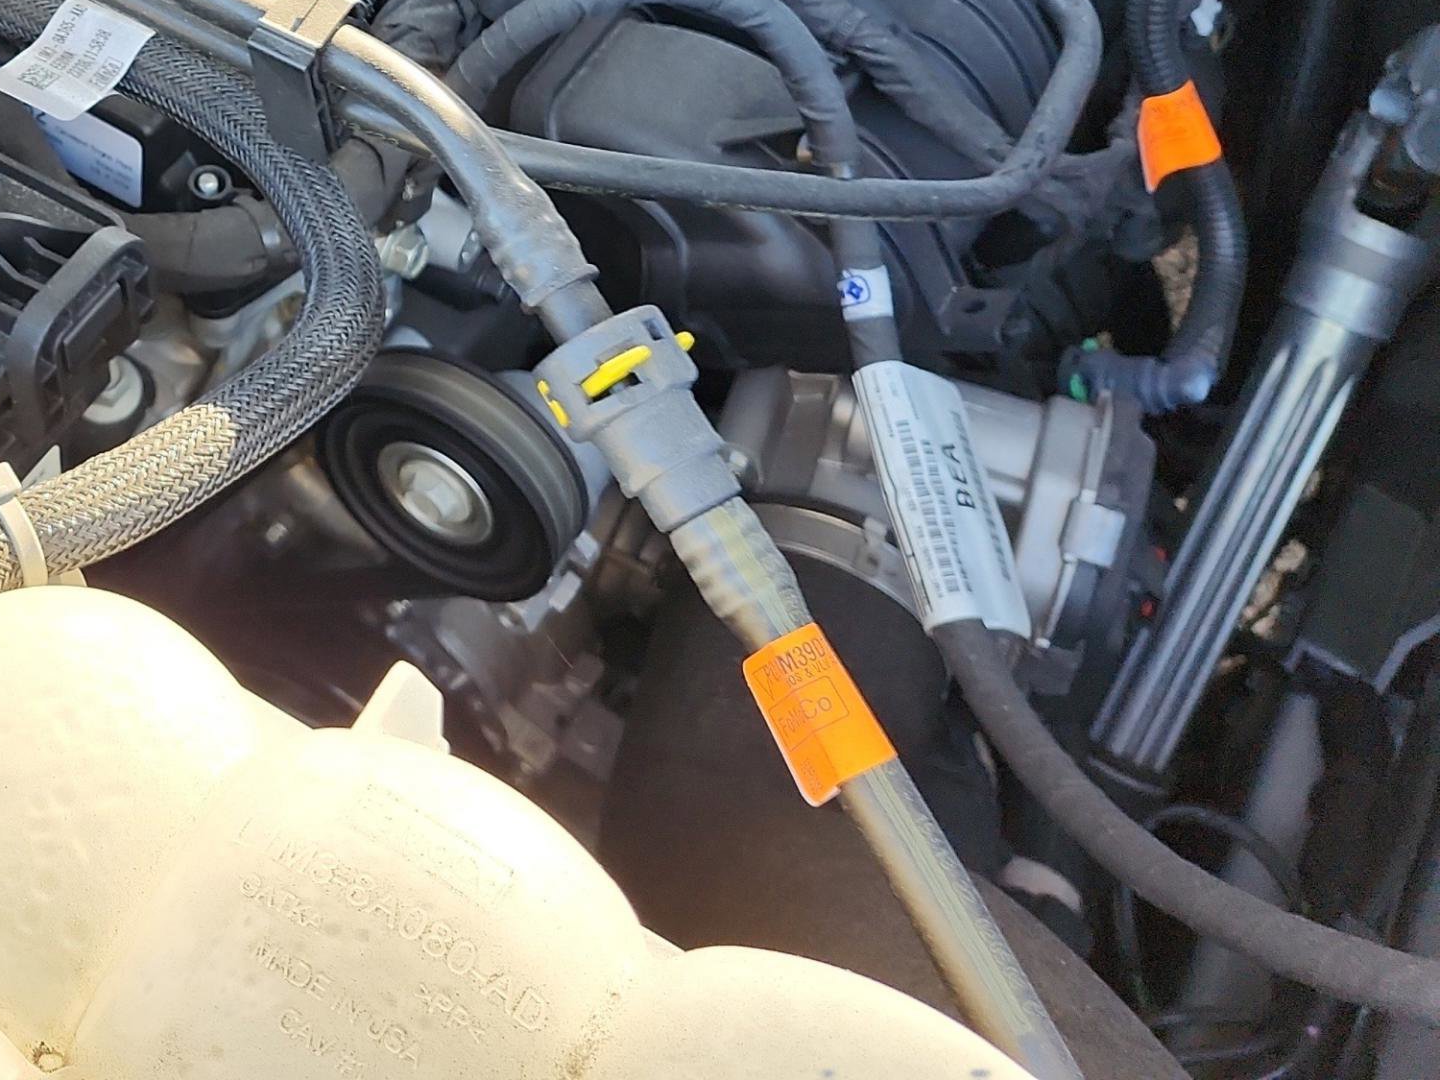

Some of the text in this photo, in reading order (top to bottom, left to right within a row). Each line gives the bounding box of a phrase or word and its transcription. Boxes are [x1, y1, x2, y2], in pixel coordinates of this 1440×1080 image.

[941, 443, 977, 511] BEA
[251, 940, 334, 1002] MADE
[366, 1016, 424, 1070] USA
